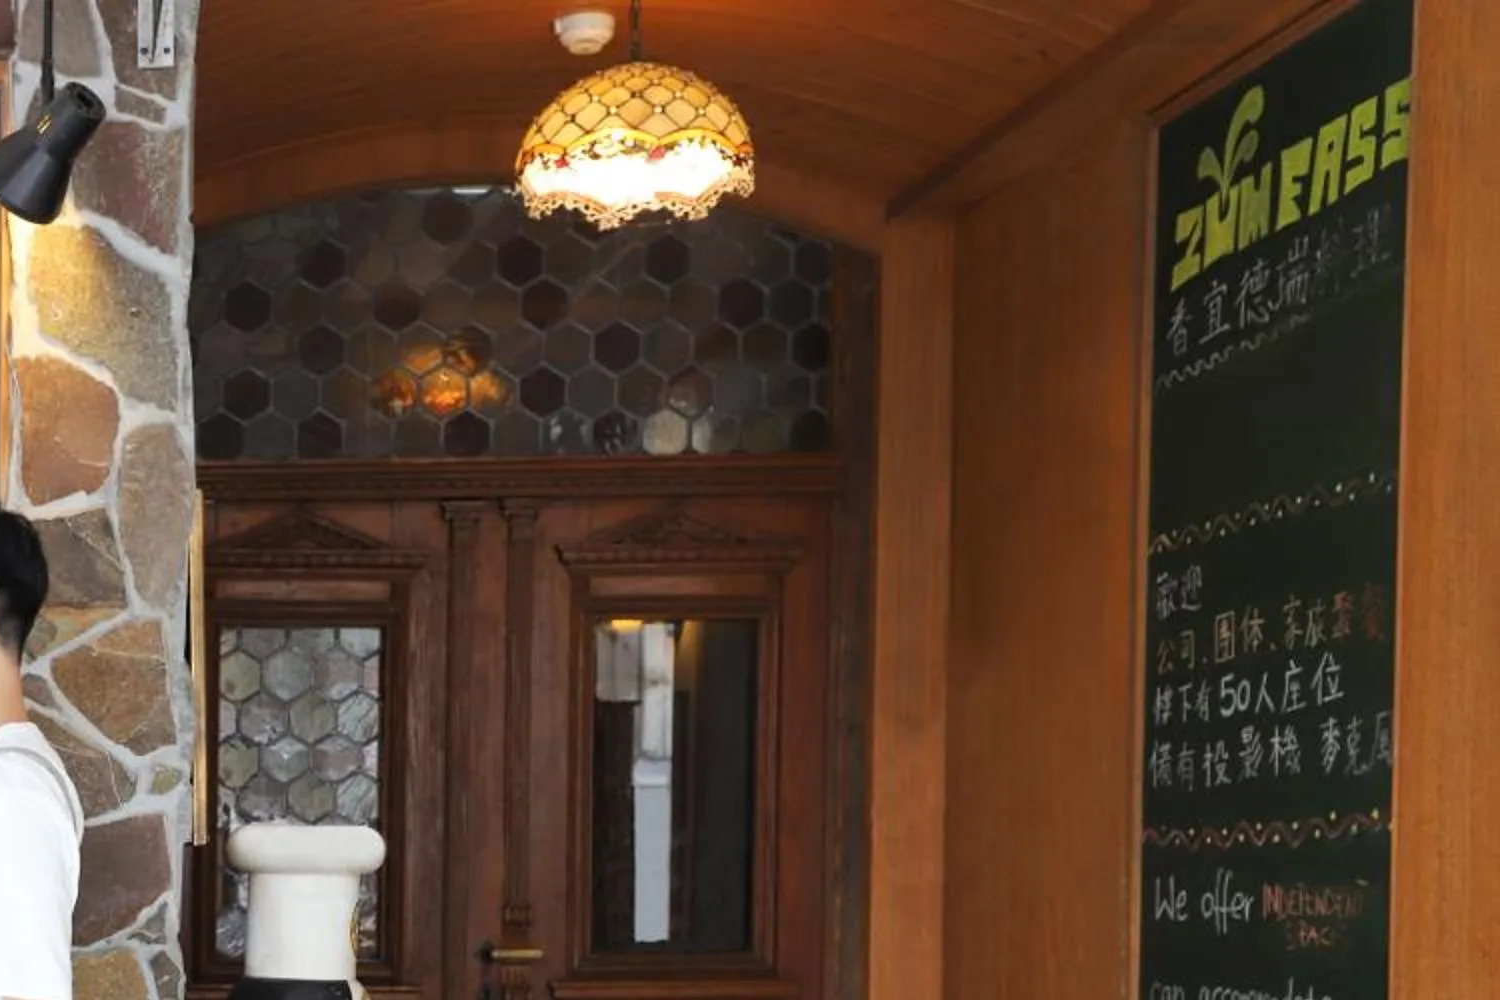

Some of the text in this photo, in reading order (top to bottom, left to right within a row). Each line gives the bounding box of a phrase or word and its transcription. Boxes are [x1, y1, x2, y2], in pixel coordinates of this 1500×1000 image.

[1170, 76, 1411, 292] ZUM FASS
[1154, 874, 1188, 922] We
[1201, 867, 1254, 936] offer
